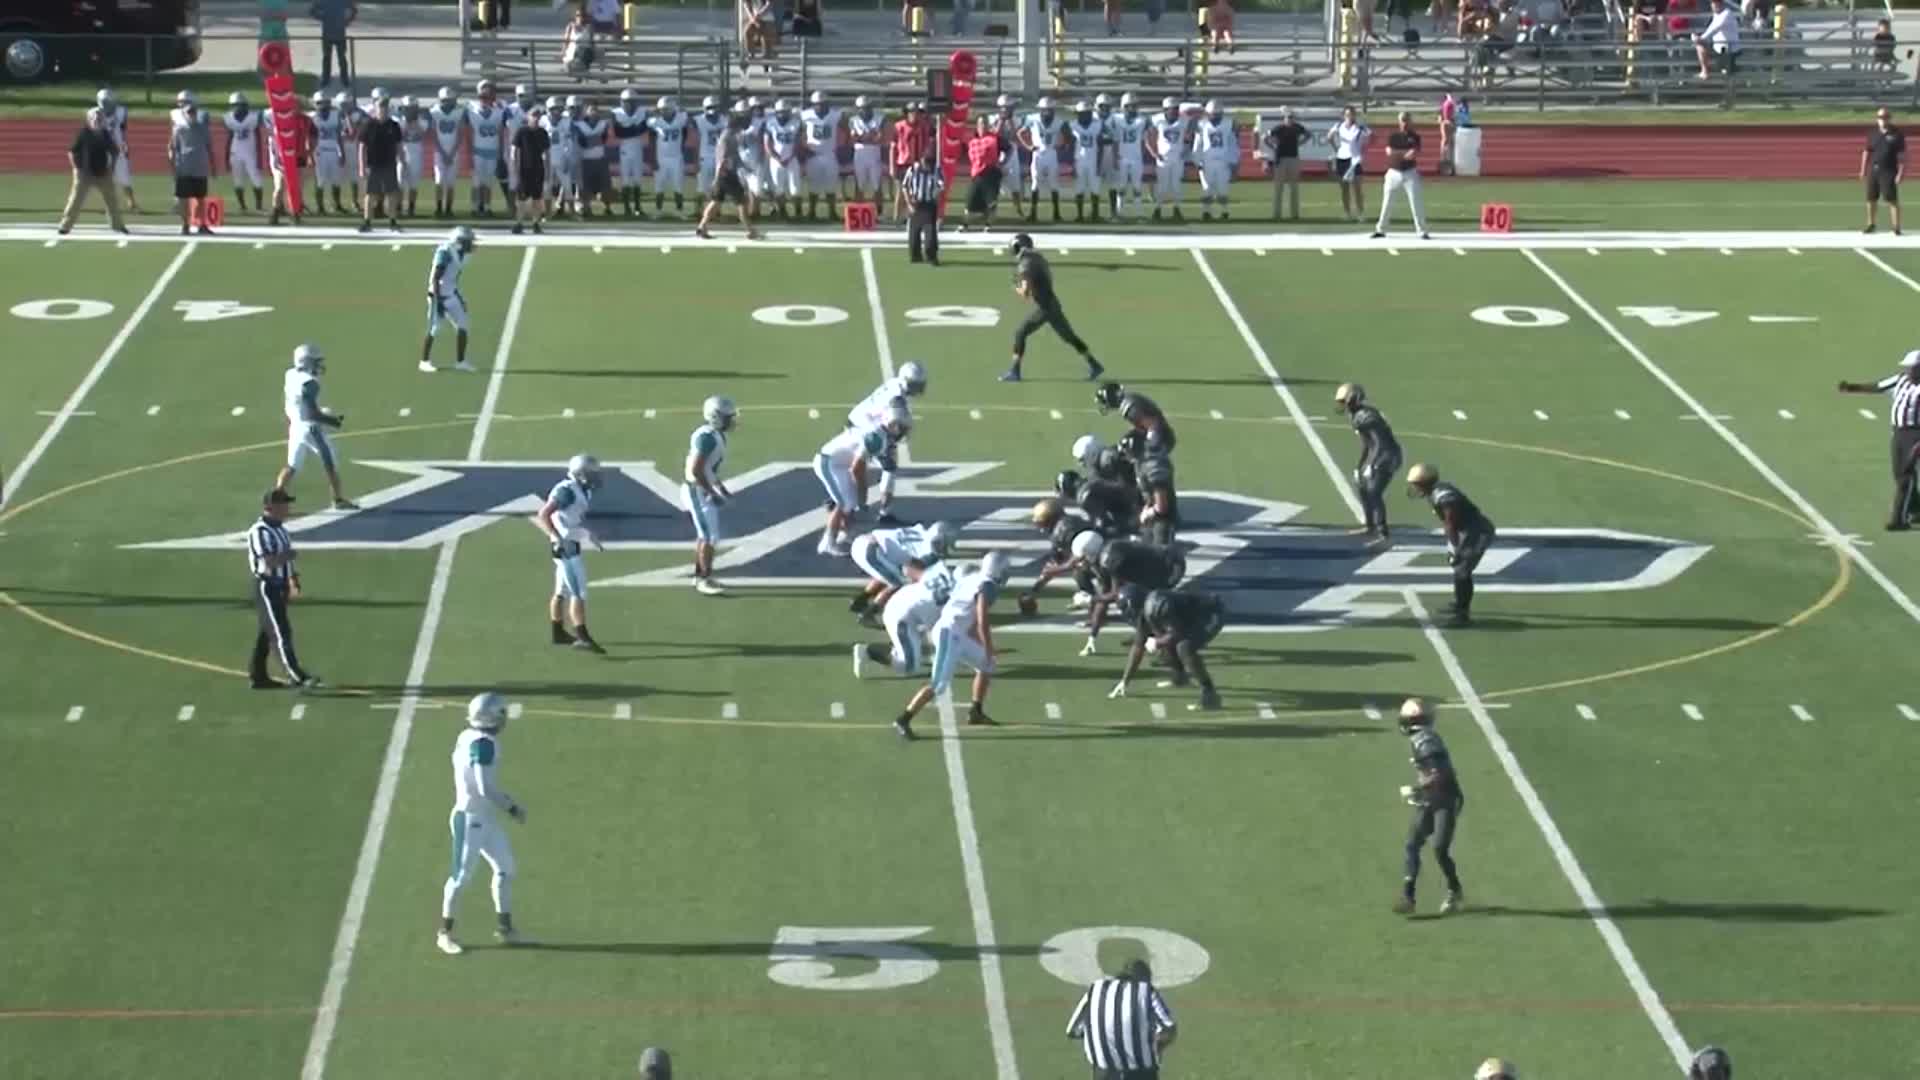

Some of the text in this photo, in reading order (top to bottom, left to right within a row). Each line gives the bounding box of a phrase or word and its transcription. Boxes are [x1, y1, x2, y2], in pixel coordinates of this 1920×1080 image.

[848, 206, 873, 230] 50
[1484, 206, 1508, 229] 40
[767, 925, 1211, 990] 50
